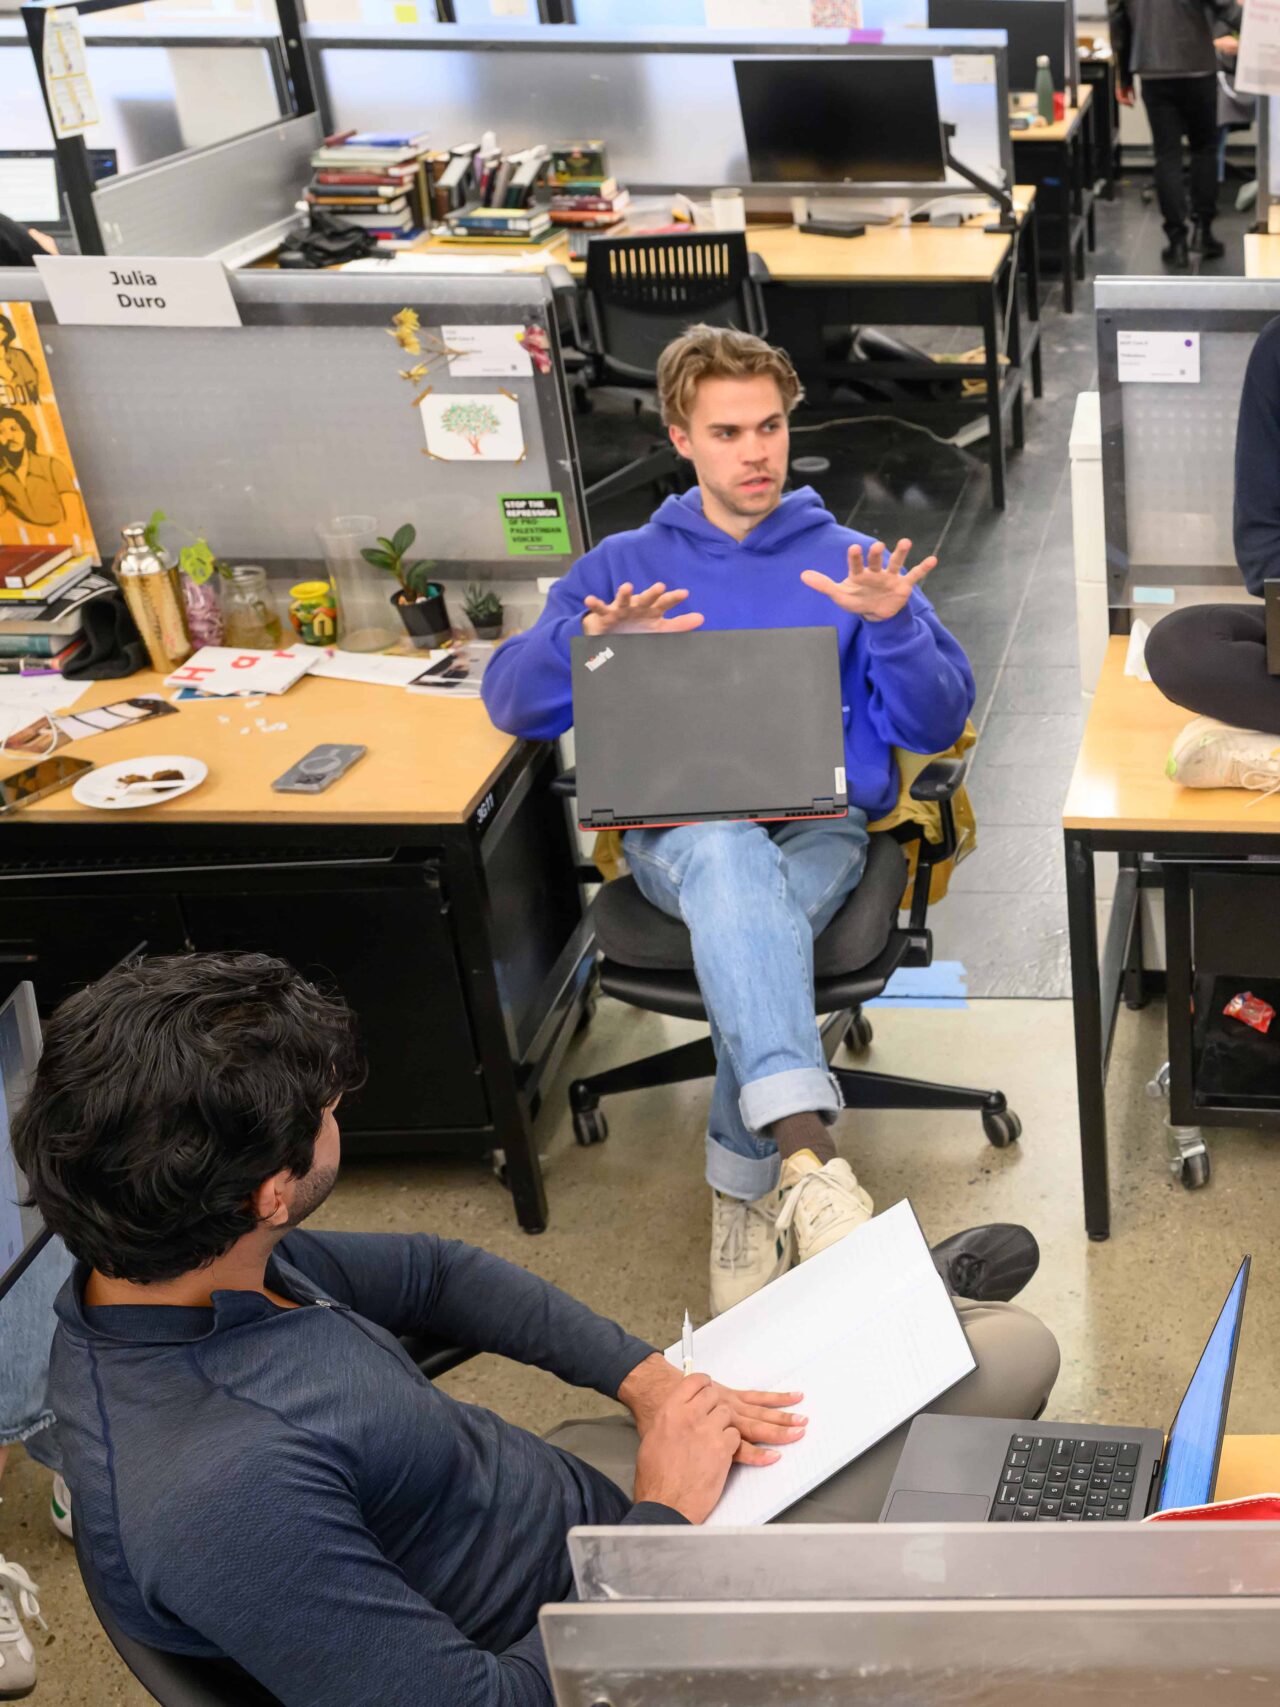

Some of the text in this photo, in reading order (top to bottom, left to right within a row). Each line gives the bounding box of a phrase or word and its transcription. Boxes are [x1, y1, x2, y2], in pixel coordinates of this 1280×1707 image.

[109, 270, 157, 286] Julia
[117, 293, 166, 309] Duro
[504, 500, 545, 509] STOP THE
[505, 509, 558, 517] REPRESSION
